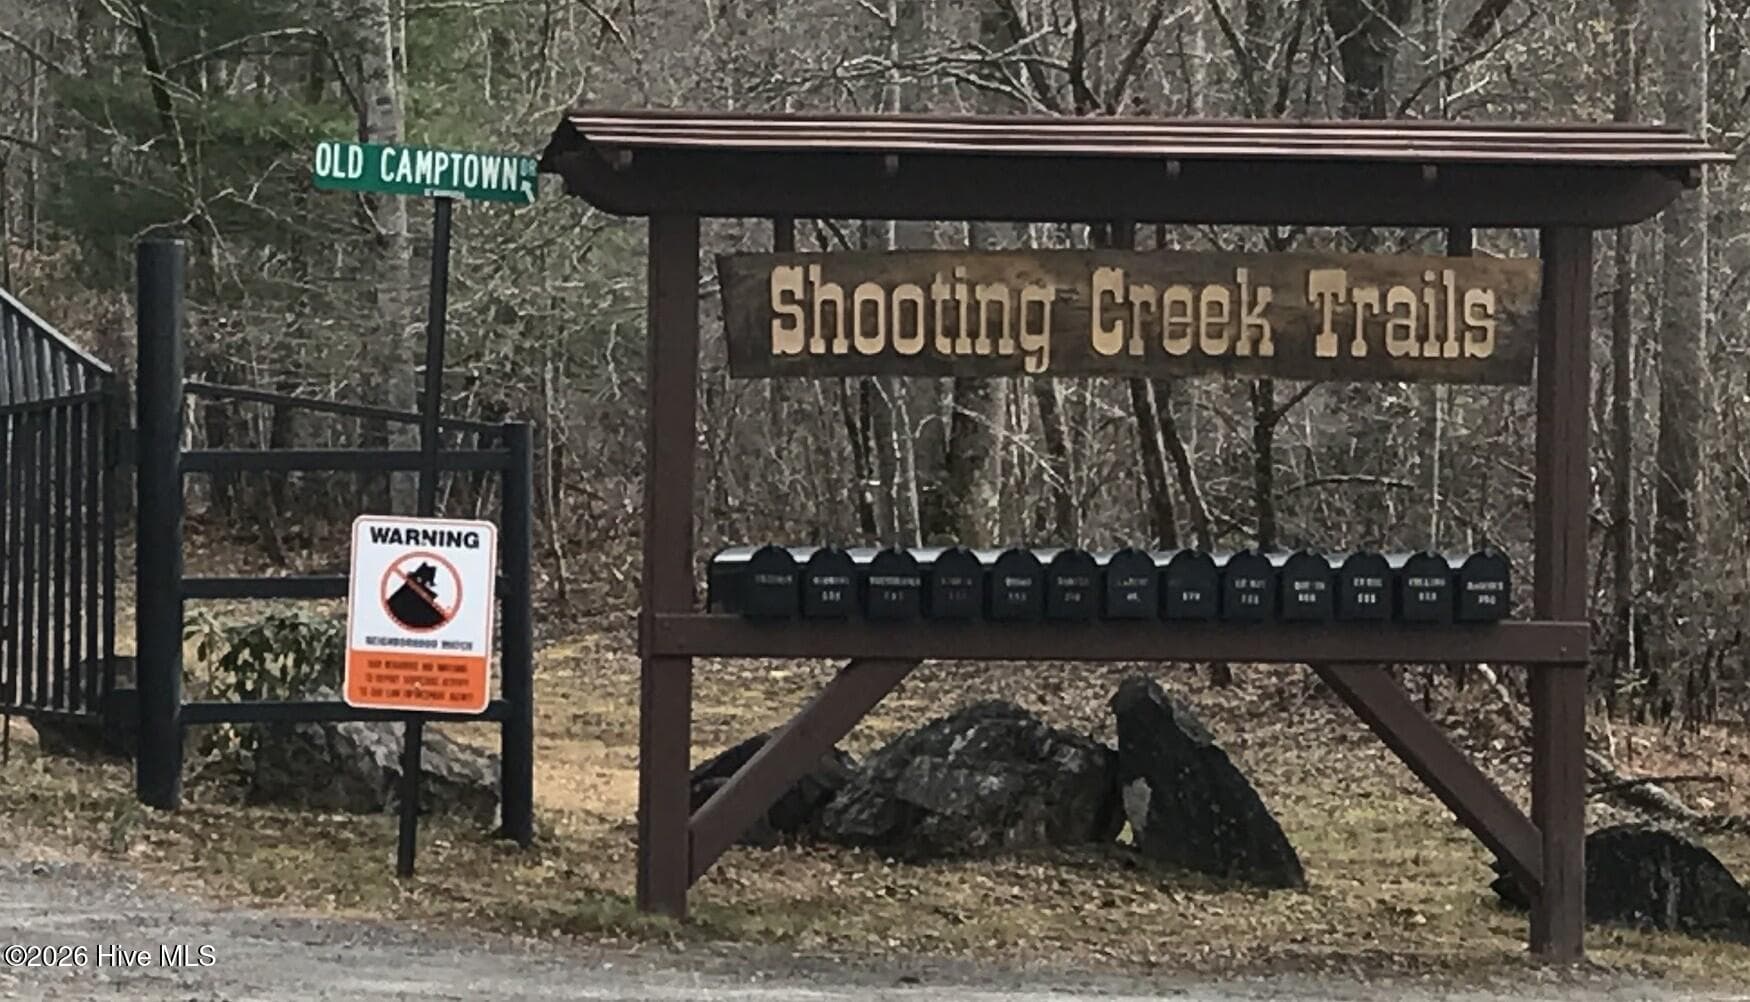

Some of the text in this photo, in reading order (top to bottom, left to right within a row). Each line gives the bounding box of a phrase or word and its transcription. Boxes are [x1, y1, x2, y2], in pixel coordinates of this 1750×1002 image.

[315, 143, 538, 191] OLD CAMPTOWN DR
[770, 264, 1496, 374] Shooting Creek Trails
[370, 527, 480, 549] WARNING
